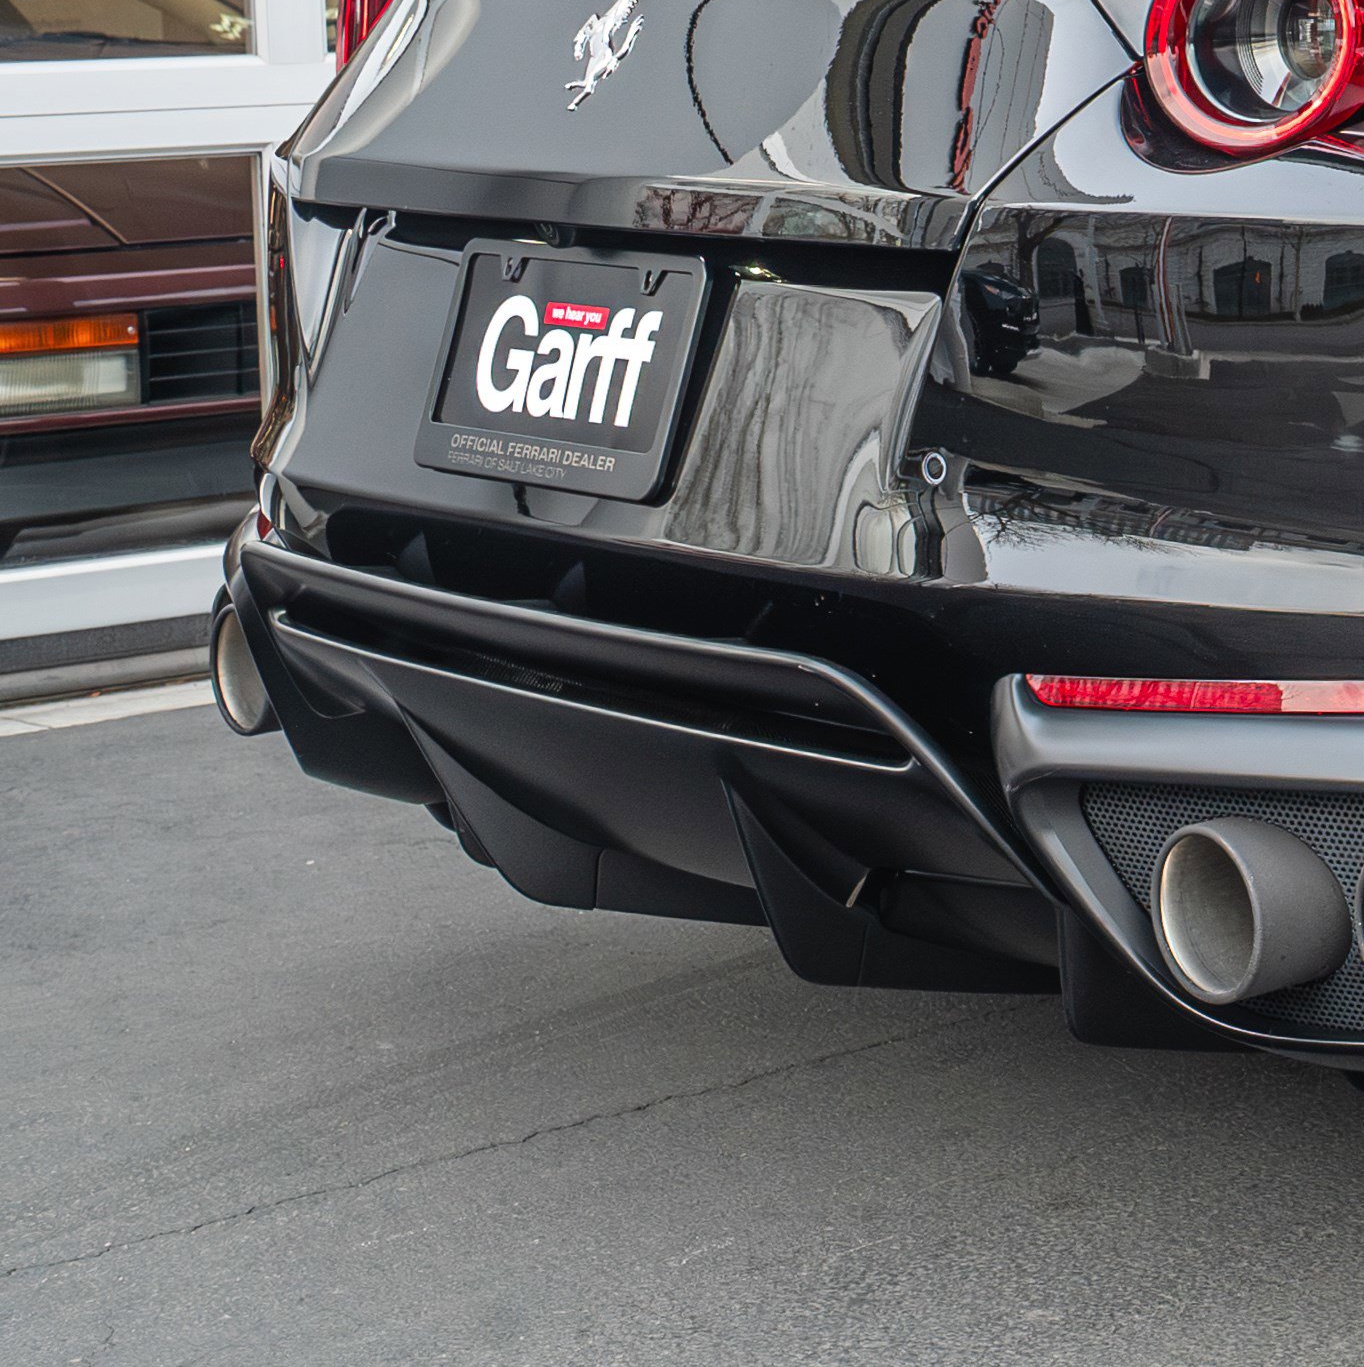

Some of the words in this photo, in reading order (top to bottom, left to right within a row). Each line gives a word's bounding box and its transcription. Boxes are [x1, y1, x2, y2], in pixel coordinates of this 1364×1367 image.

[552, 308, 564, 319] we
[565, 306, 585, 321] hear
[583, 312, 602, 325] you
[476, 295, 663, 428] Garff
[448, 450, 483, 467] FERRARI
[484, 457, 498, 470] OF
[498, 459, 521, 473] SALT
[521, 462, 545, 477] LAKE
[545, 466, 567, 480] CITY
[451, 434, 504, 455] OFFICIAL
[507, 442, 560, 464] FERRARI
[563, 451, 615, 472] DEALER
